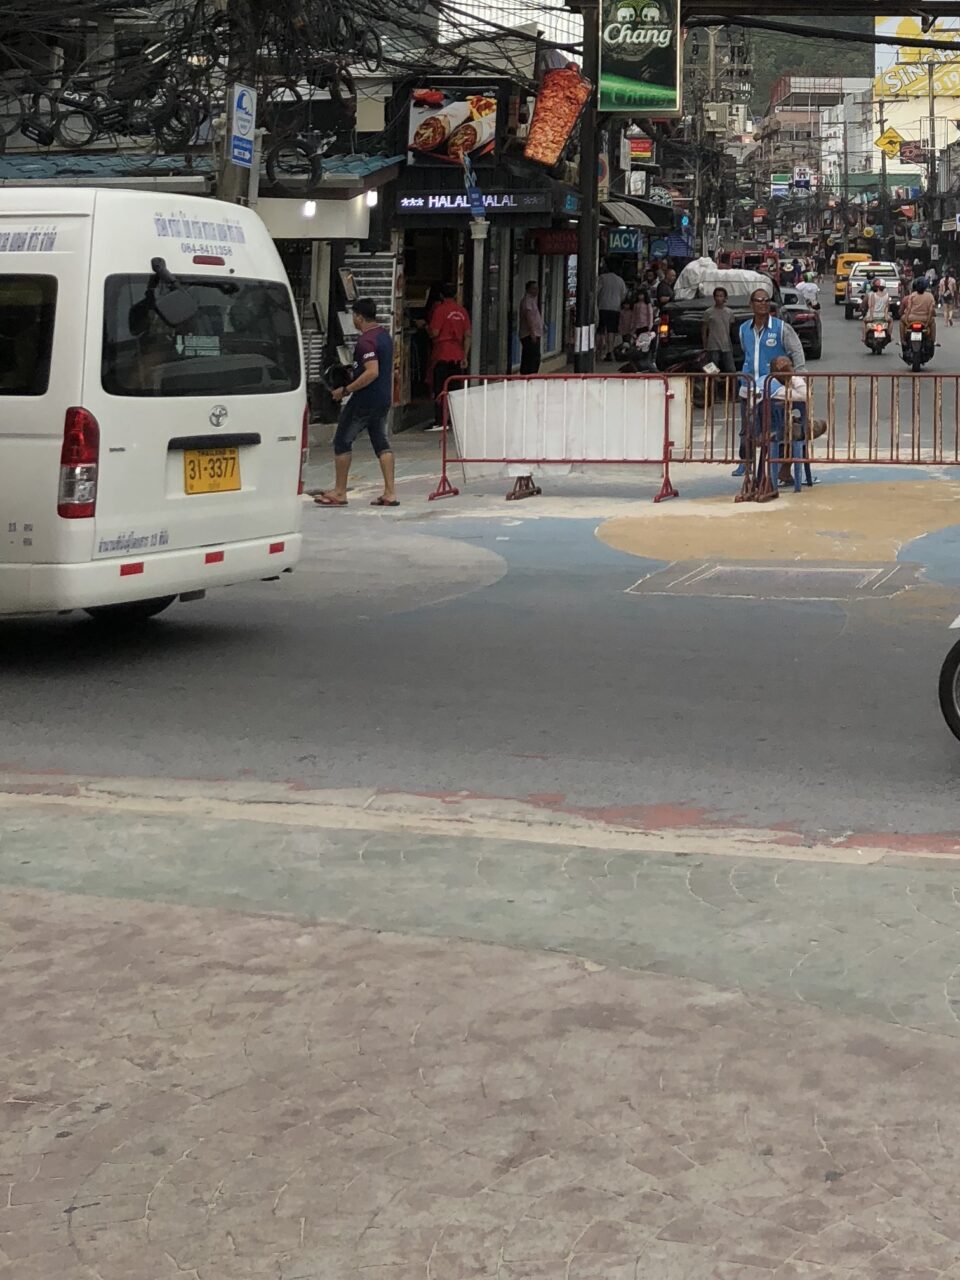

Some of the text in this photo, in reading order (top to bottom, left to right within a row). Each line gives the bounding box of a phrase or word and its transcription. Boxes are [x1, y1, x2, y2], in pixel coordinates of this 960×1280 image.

[603, 23, 673, 48] Chang
[63, 91, 88, 101] CAT
[429, 195, 471, 208] HALAL
[189, 457, 236, 480] 31-3377
